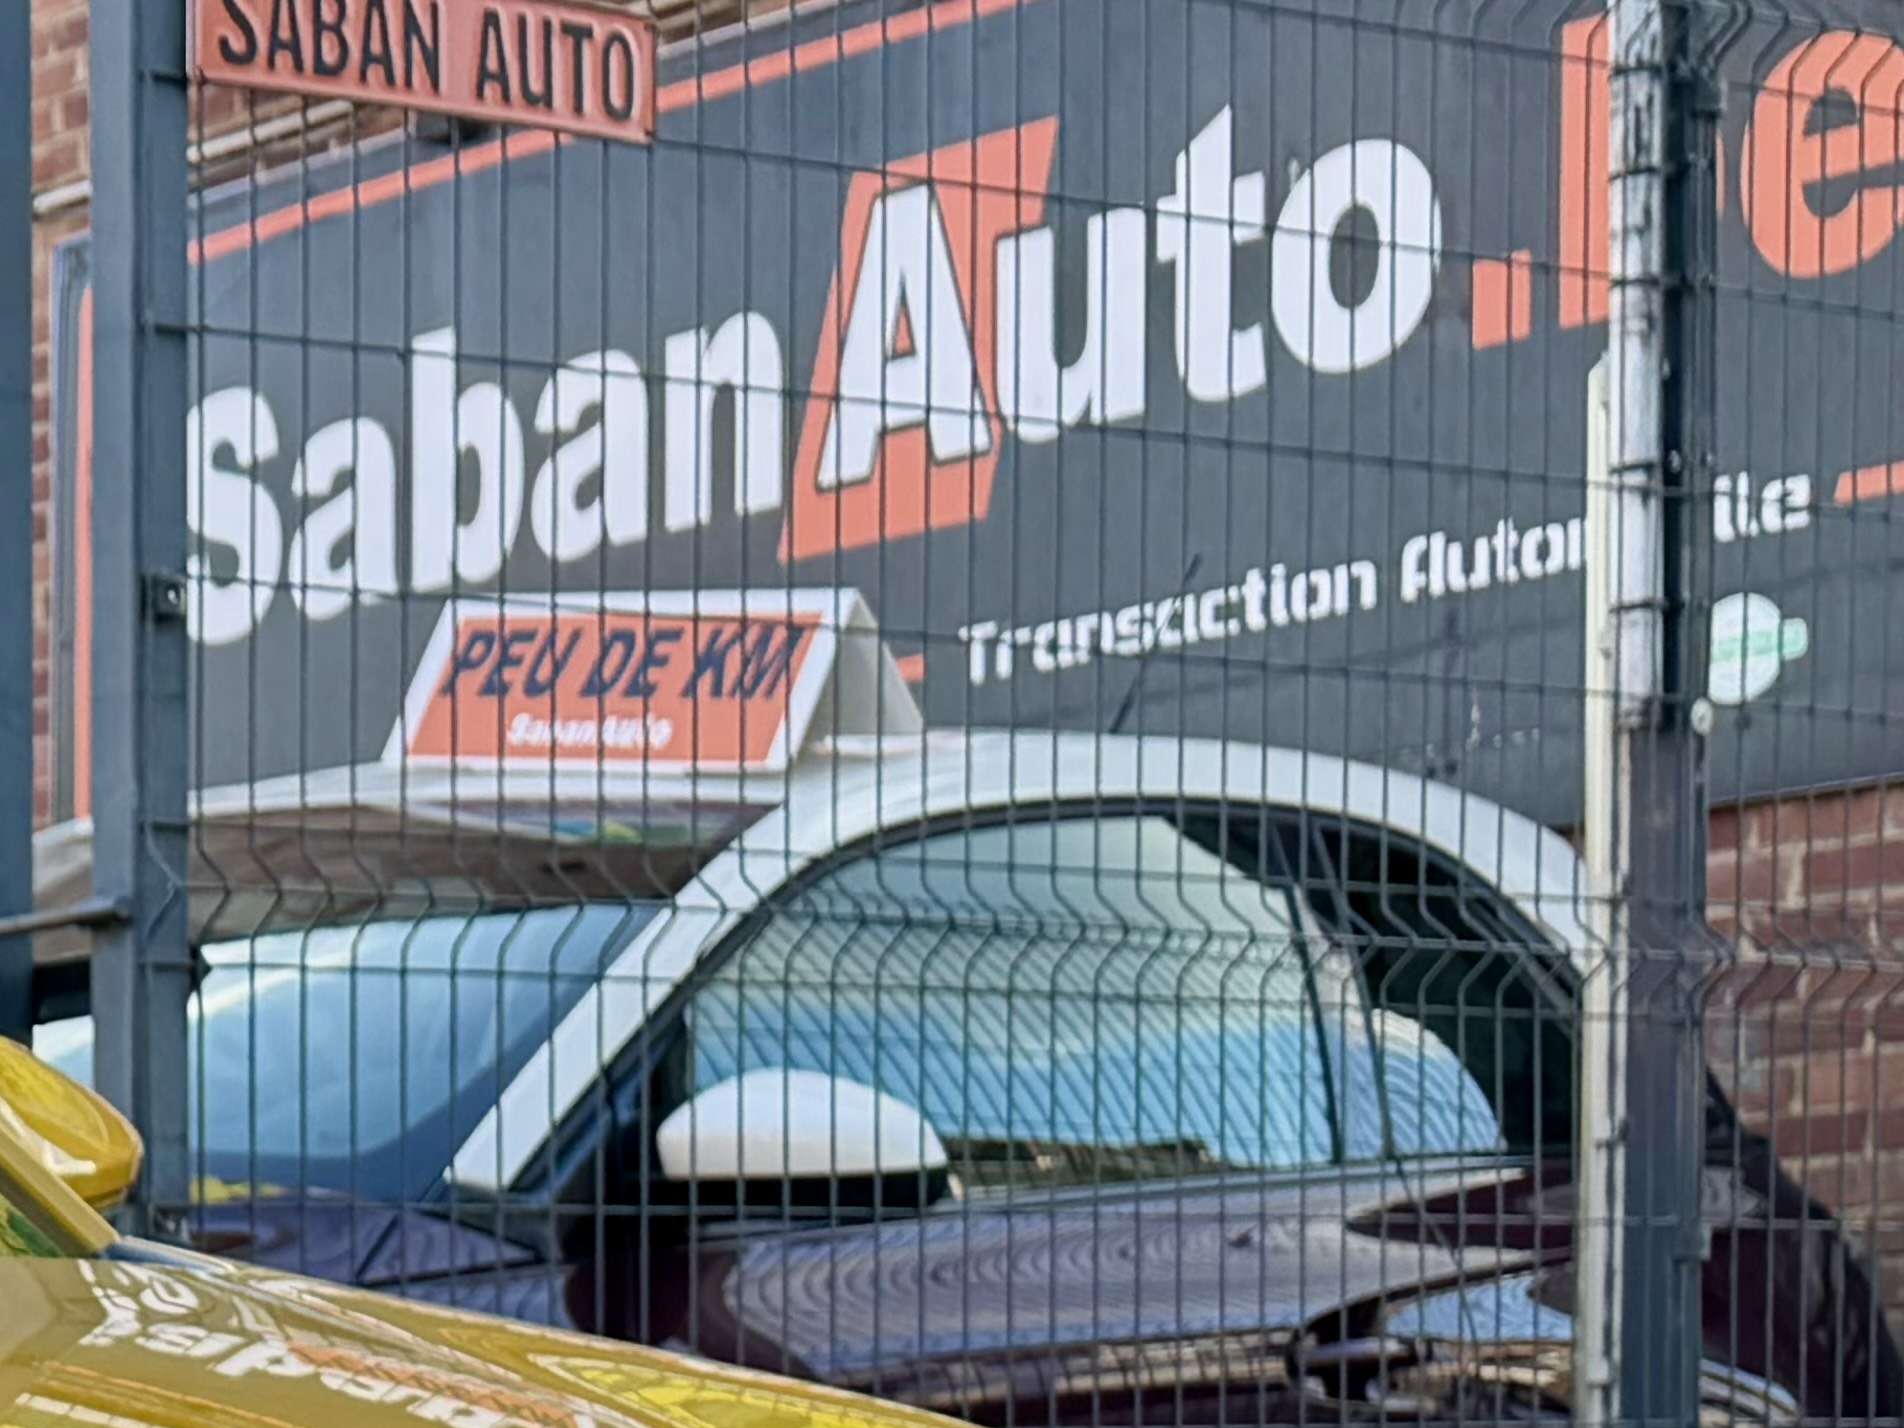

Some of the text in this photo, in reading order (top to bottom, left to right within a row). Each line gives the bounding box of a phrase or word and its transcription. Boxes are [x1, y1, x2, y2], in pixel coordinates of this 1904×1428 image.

[218, 0, 634, 121] SABAN AUTO
[439, 626, 808, 699] PEU DE KM
[959, 556, 1378, 685] Transaction
